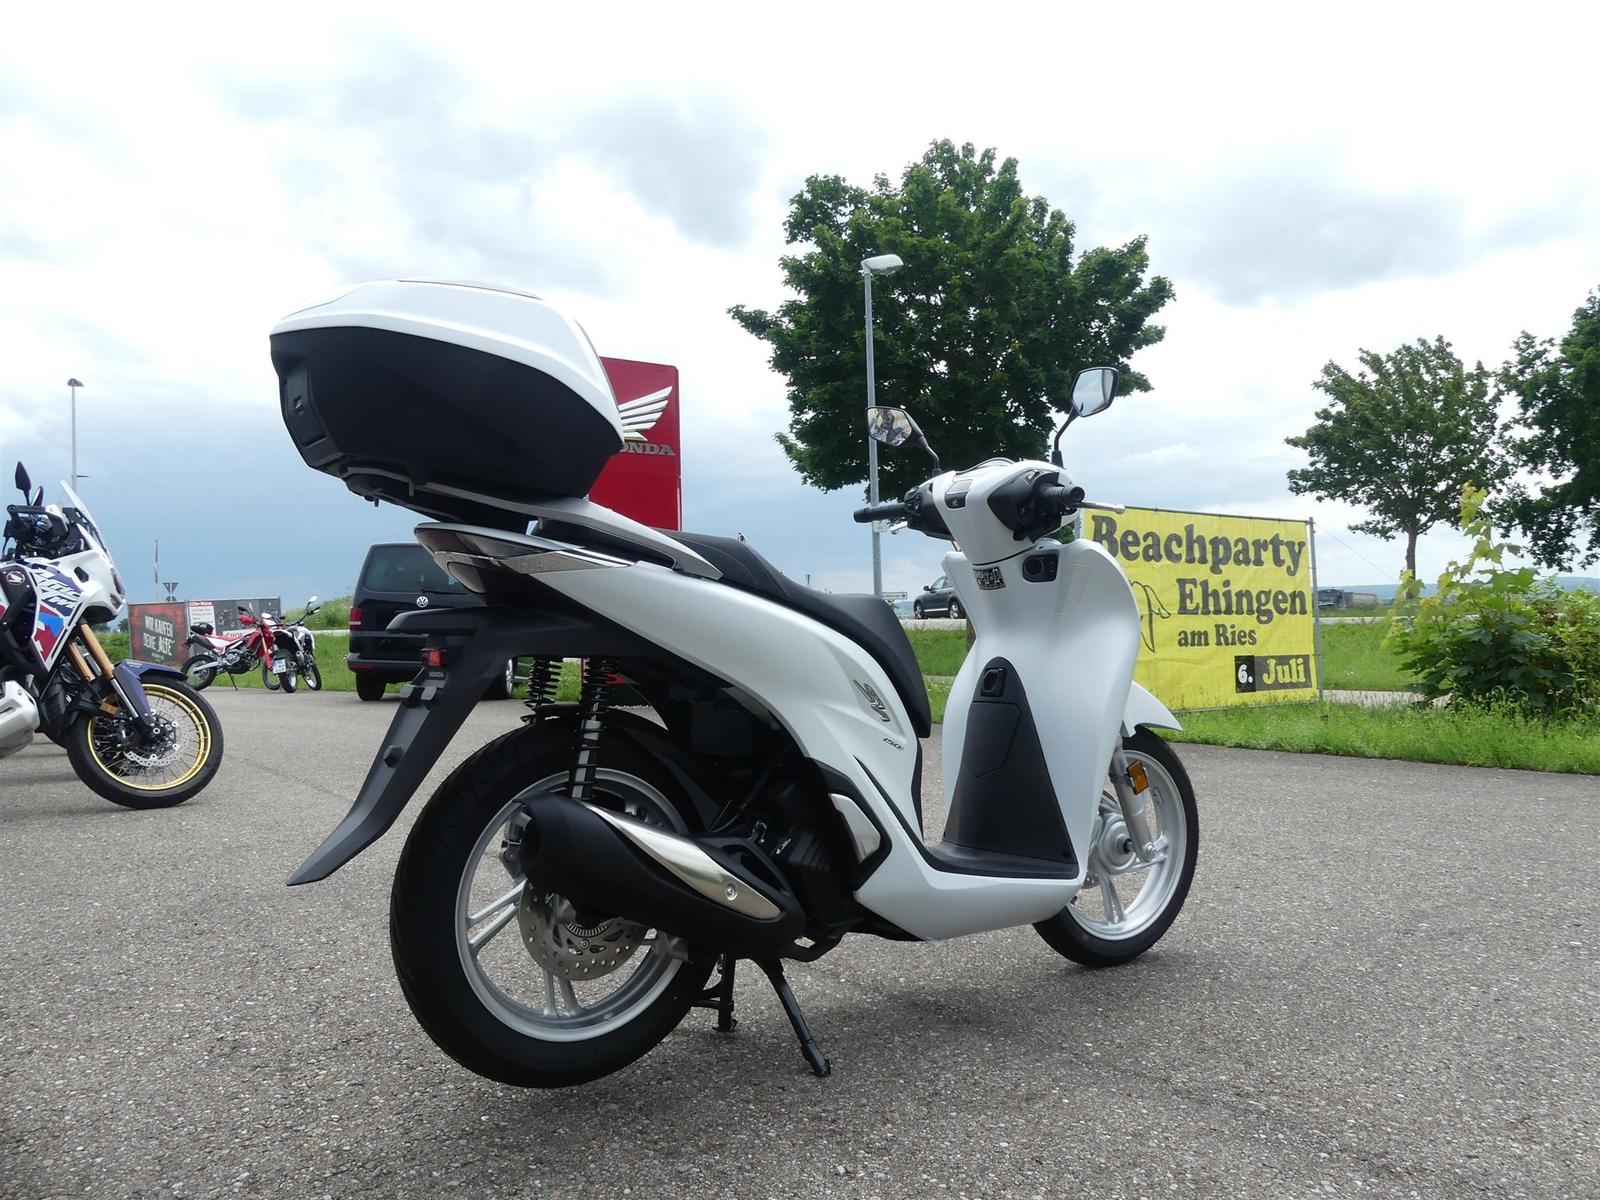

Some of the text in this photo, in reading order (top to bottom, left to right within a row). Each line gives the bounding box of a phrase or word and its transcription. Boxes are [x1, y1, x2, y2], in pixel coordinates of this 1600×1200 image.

[1091, 514, 1306, 577] Beachparty
[1176, 577, 1308, 624] Ehingen
[1177, 623, 1257, 647] am Ries
[1237, 657, 1306, 684] 6. Juli
